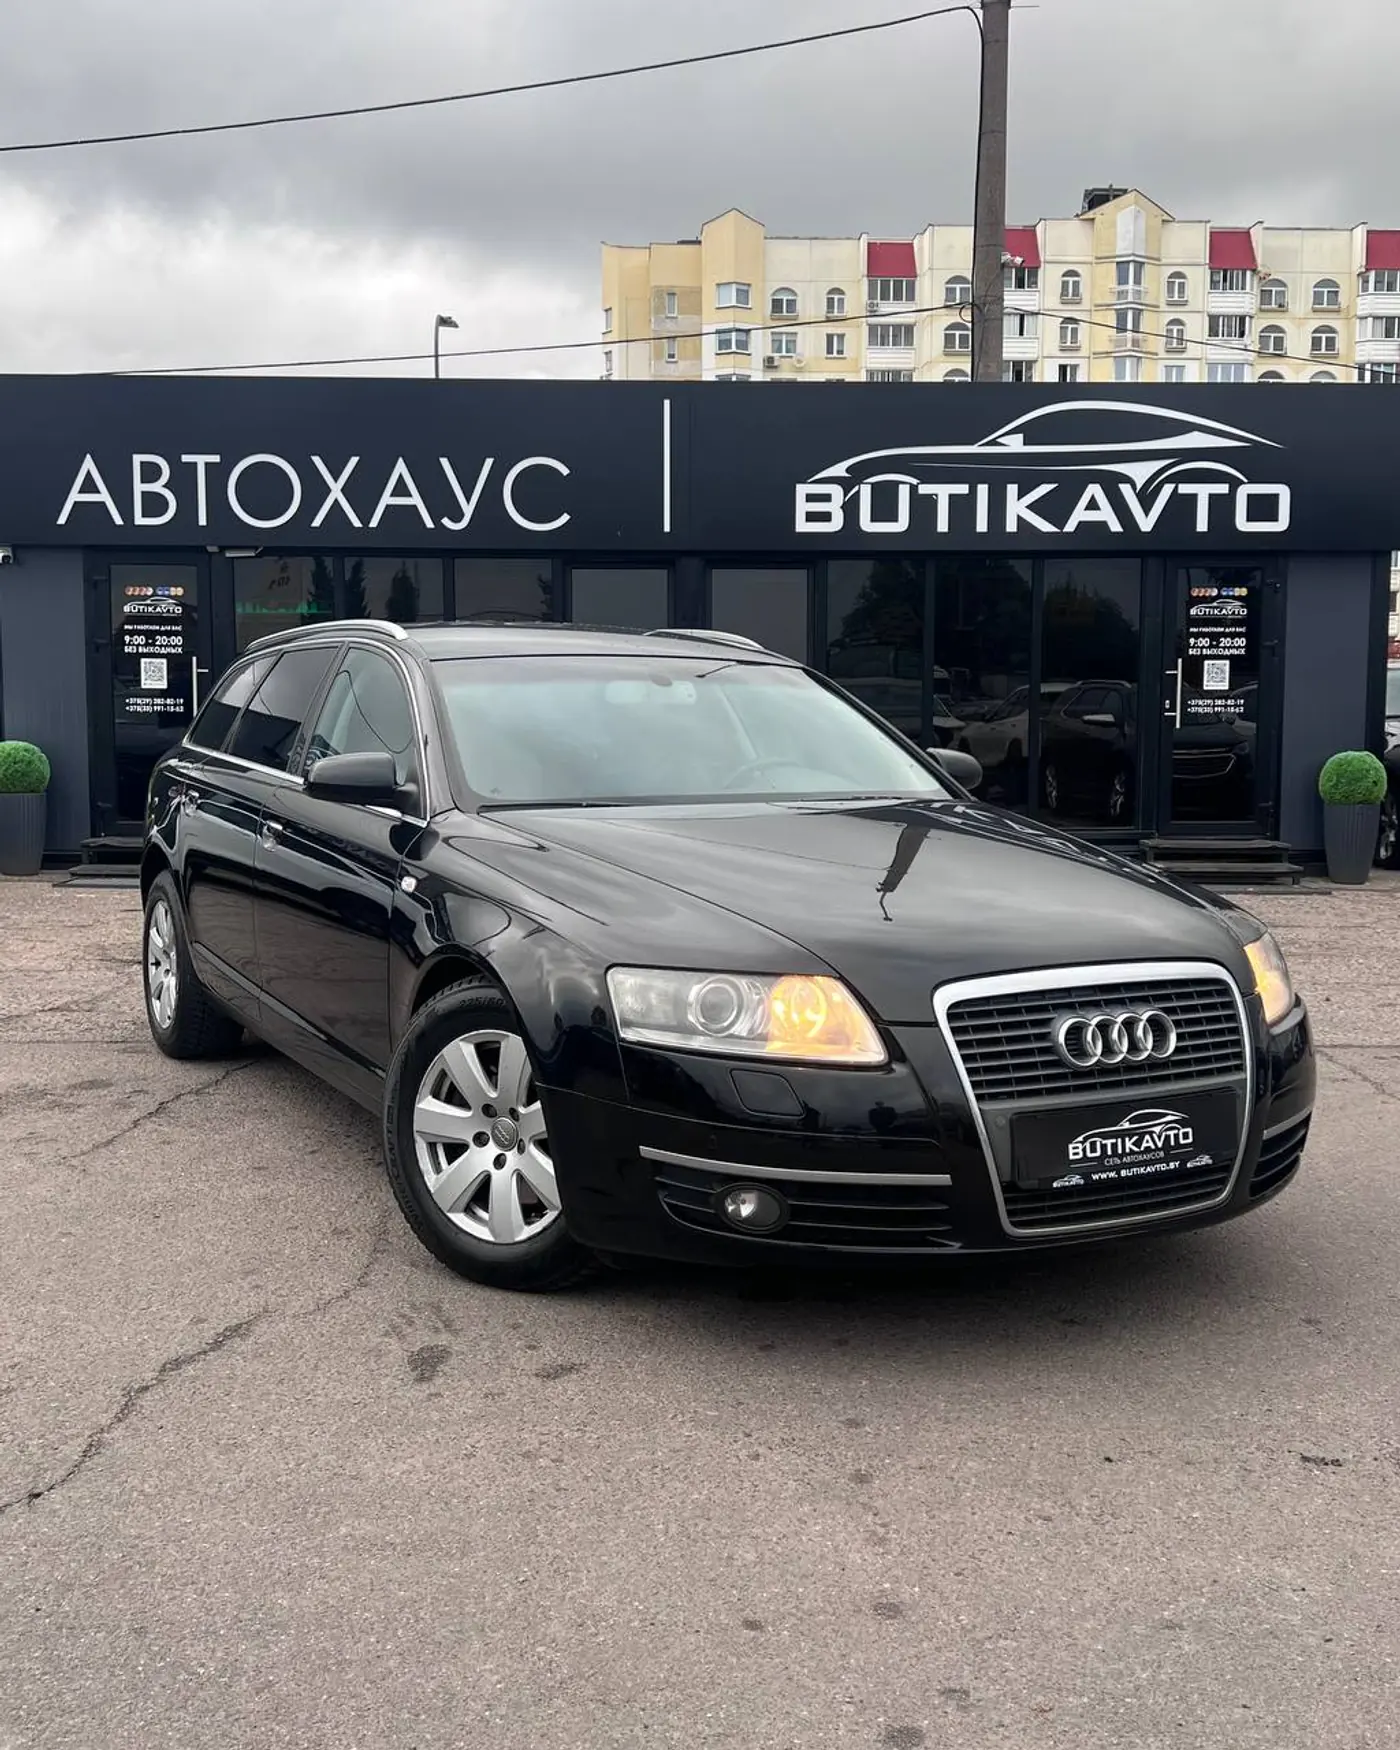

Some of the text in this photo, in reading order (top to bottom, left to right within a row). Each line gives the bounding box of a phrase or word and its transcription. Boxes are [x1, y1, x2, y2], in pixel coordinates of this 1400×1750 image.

[56, 453, 571, 532] АВТОХАУС
[795, 482, 1291, 533] BUTIKAVTO
[124, 635, 146, 645] 9:00
[155, 635, 183, 645] 20:00
[1189, 637, 1210, 647] 9:00
[1219, 637, 1247, 647] 20:00
[124, 645, 183, 654] БЕЗ ВЫХОДНЫХ
[1202, 648, 1246, 656] ВЫХОДНЫХ
[1068, 1127, 1194, 1161] BUTIKAVTO
